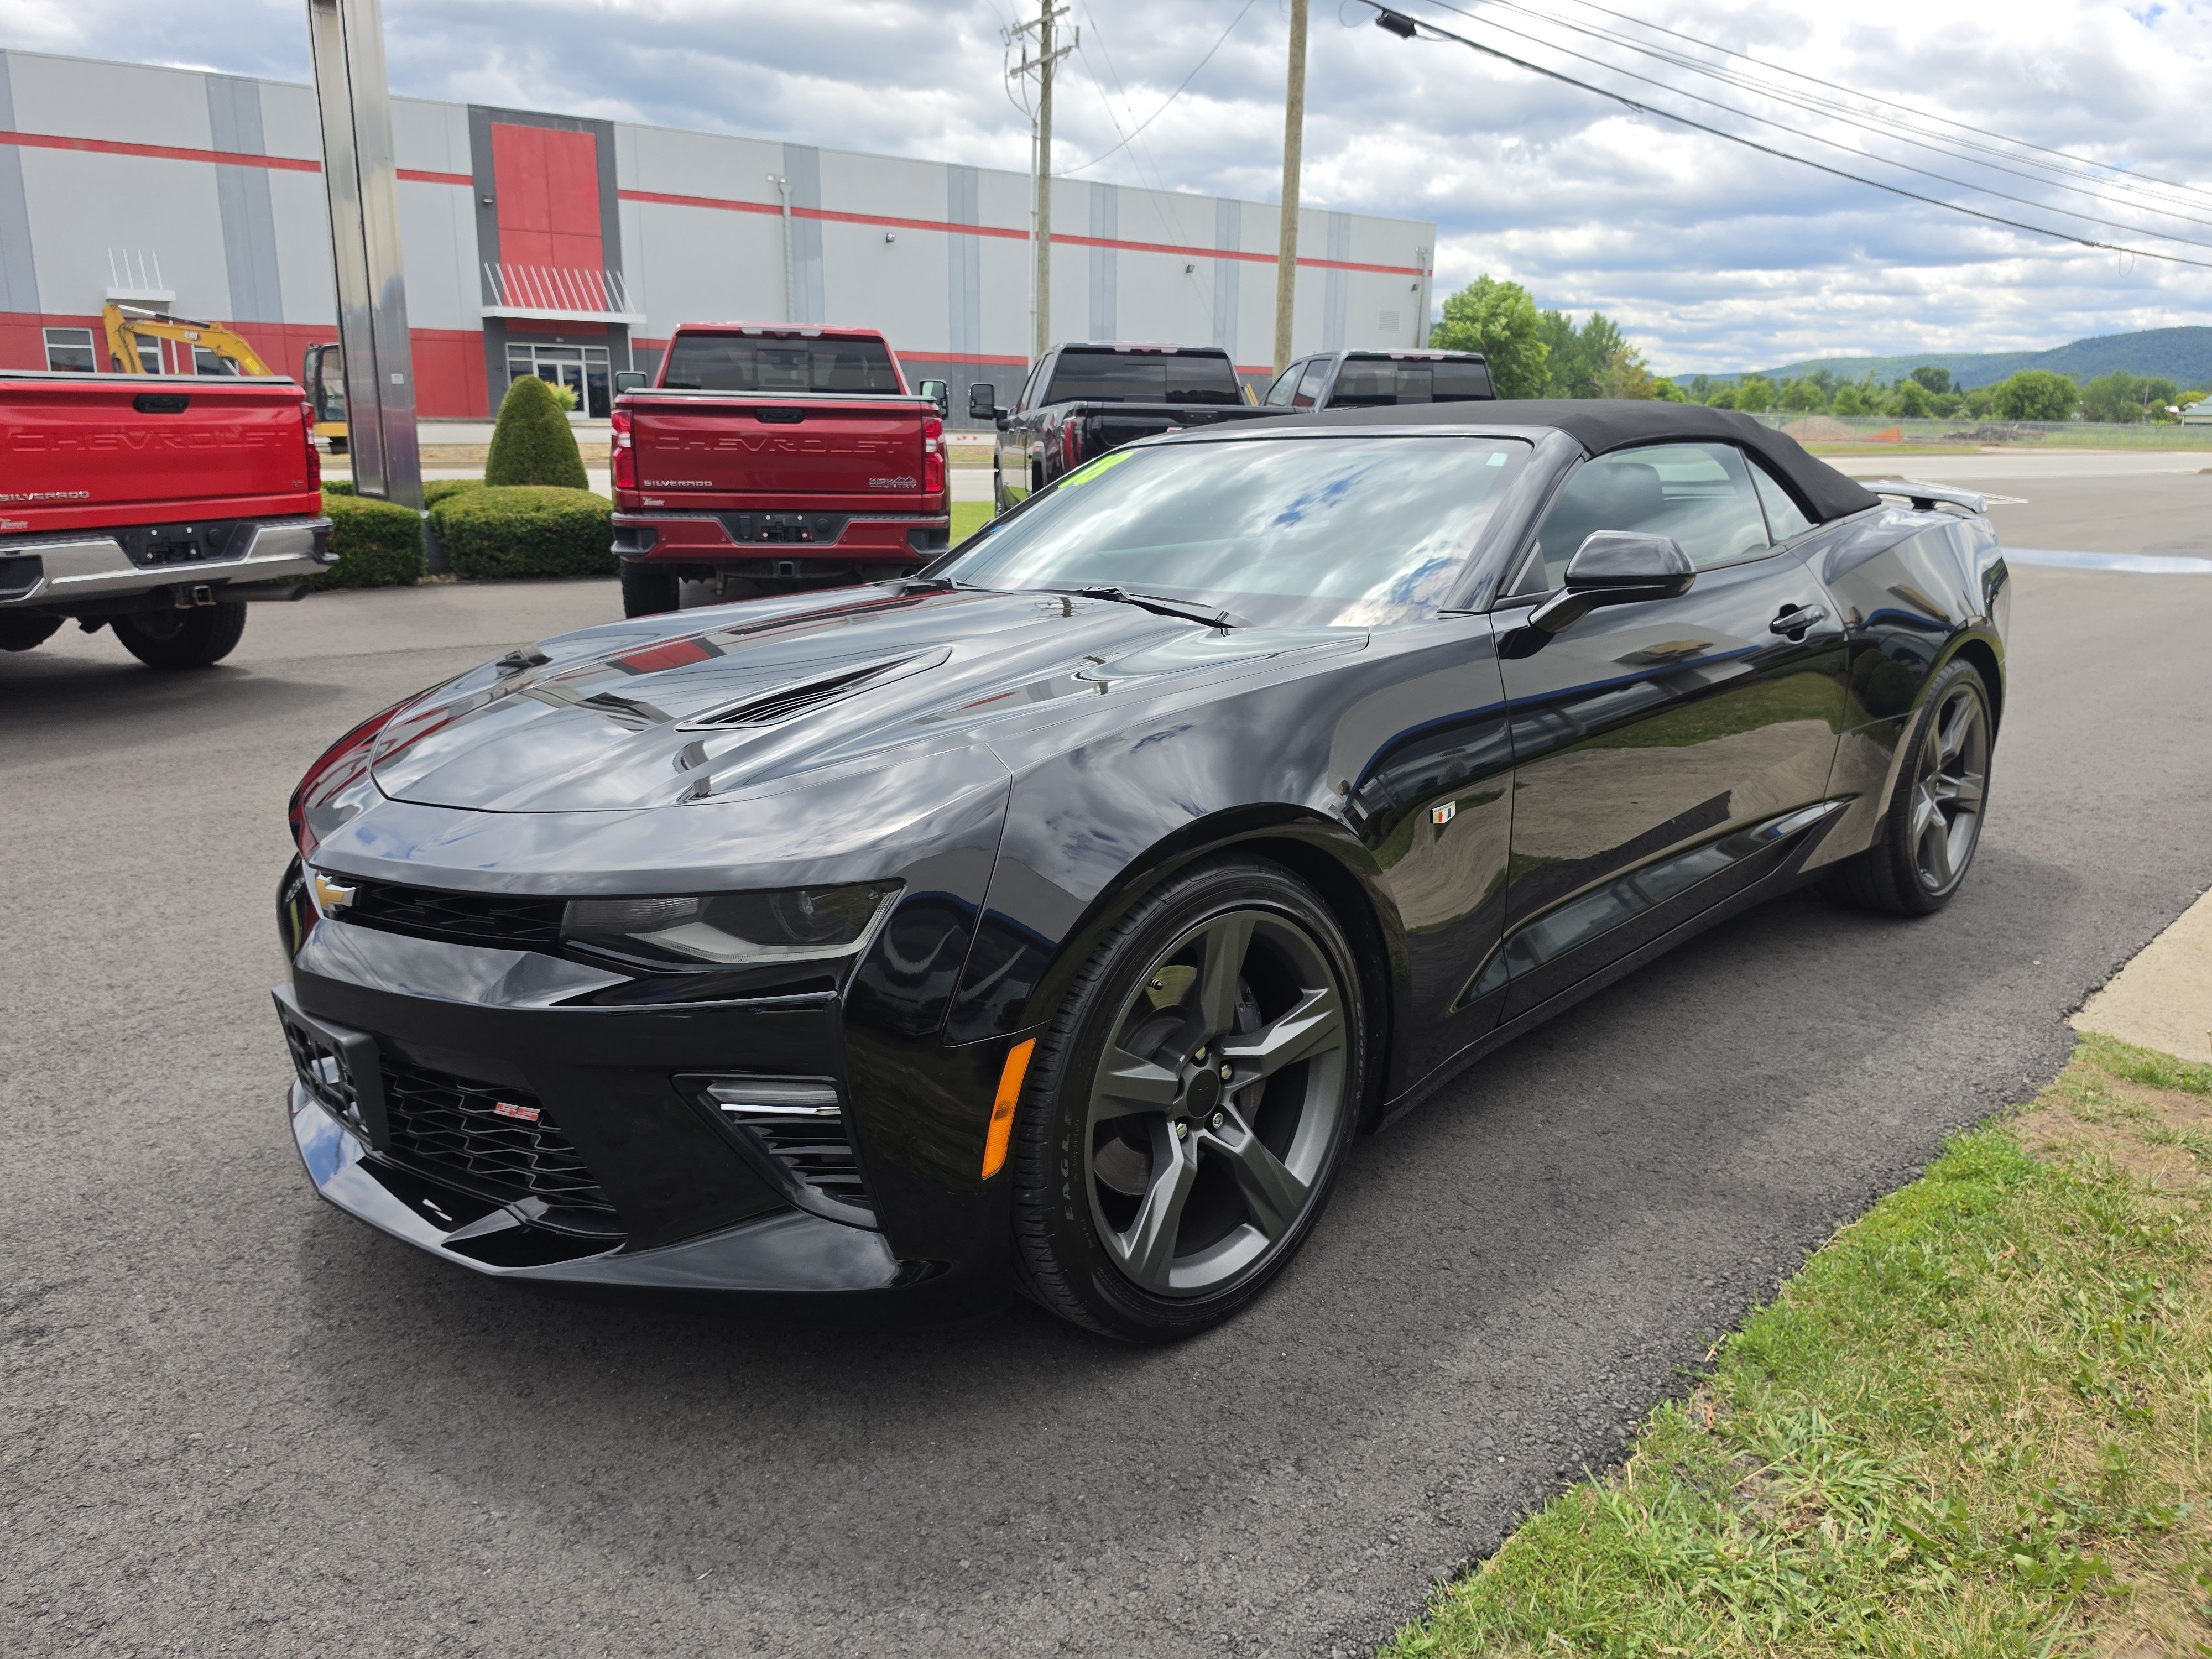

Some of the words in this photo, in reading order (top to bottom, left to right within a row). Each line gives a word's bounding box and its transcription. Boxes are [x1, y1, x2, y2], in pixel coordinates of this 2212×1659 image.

[12, 431, 289, 452] CHEVROLET
[655, 436, 904, 453] CHEVROLET
[0, 491, 90, 502] SILVERADO
[493, 1102, 541, 1121] SS
[1061, 1106, 1074, 1221] EAGLE
